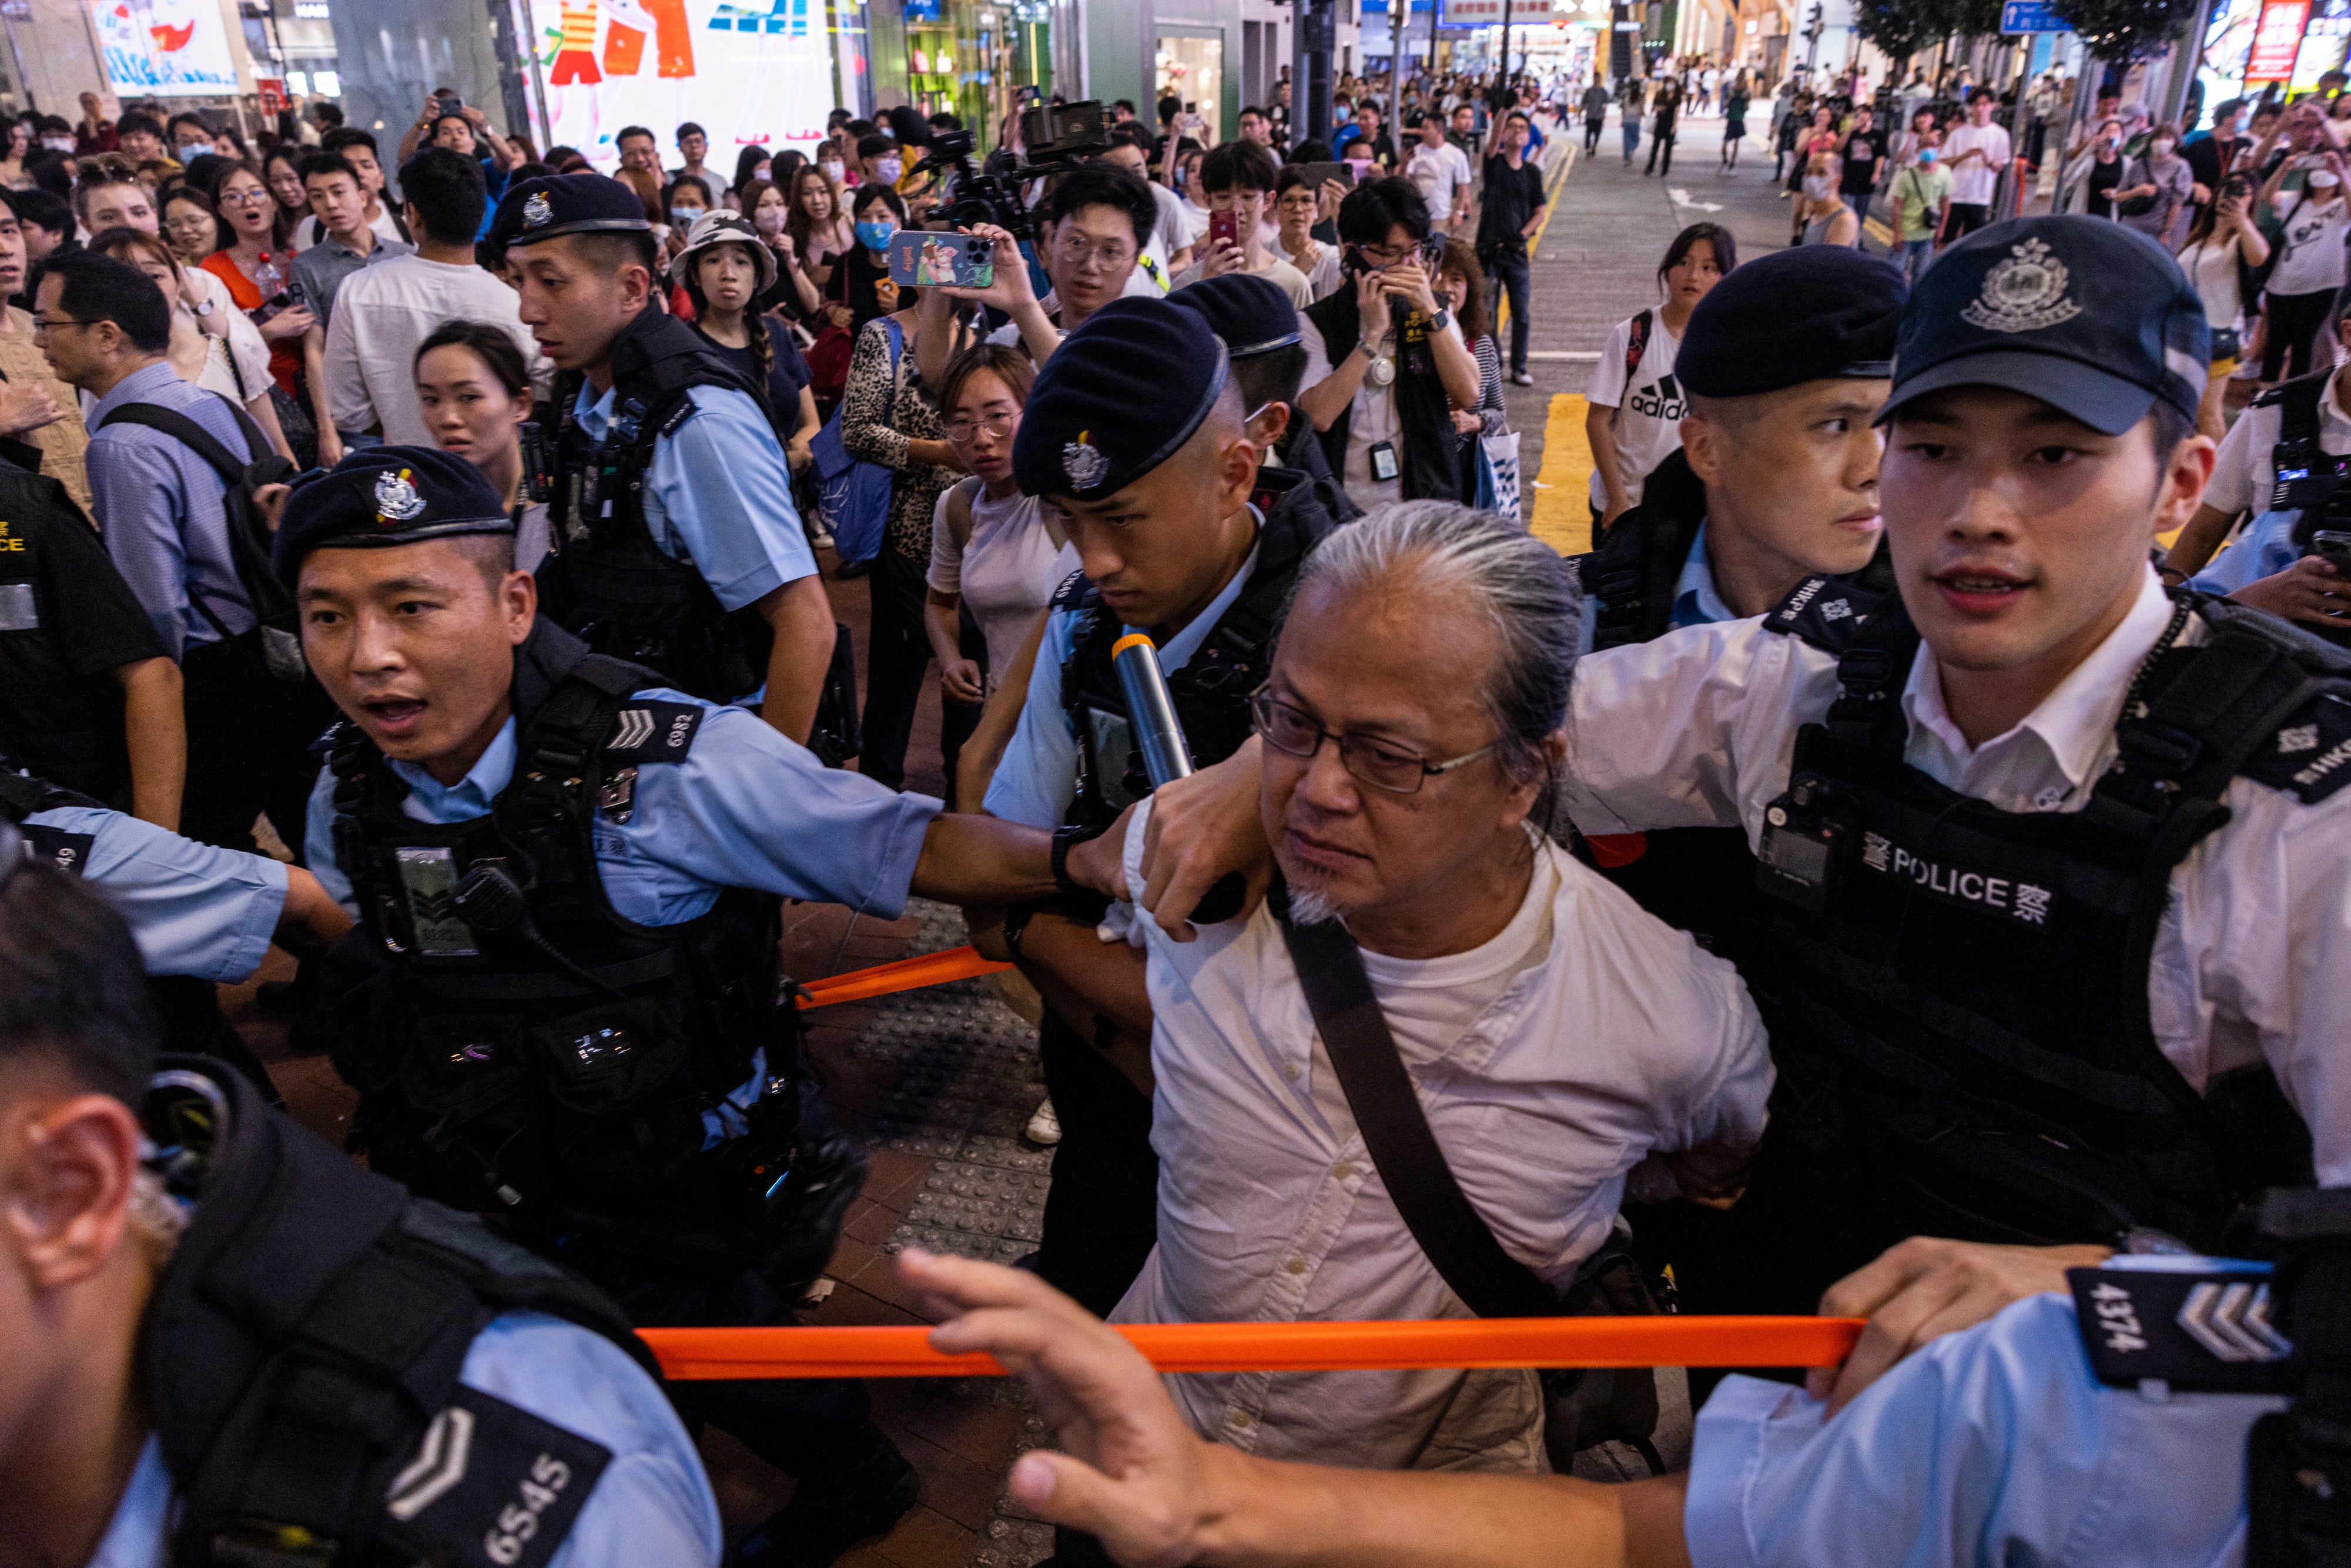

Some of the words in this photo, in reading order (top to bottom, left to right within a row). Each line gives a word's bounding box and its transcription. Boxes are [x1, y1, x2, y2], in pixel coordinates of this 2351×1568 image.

[667, 714, 694, 748] 6982
[53, 847, 77, 875] 49
[1893, 847, 2011, 908] POLICE
[2089, 1282, 2148, 1353] 4374
[485, 1452, 571, 1566] 6545
